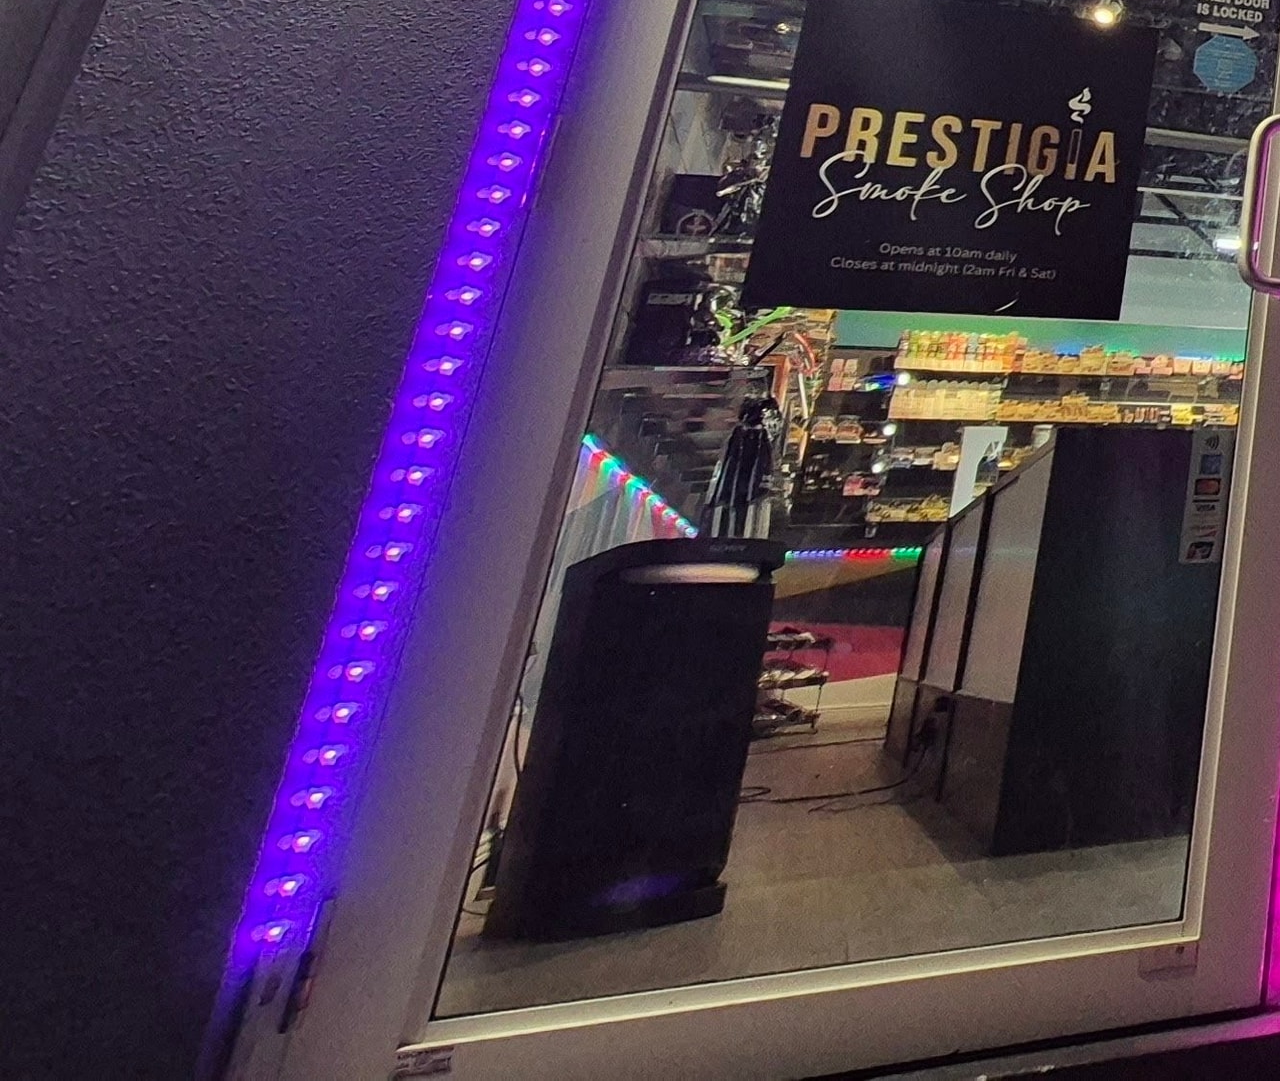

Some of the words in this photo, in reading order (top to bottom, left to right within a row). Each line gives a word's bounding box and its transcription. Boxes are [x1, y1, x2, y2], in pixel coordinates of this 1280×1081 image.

[1196, 3, 1210, 15] IS
[1213, 5, 1263, 22] LOCKED
[800, 102, 1117, 184] PRESTIGIA
[812, 150, 968, 221] Smoke
[974, 163, 1091, 236] Shop
[879, 243, 924, 257] Opens
[927, 245, 942, 257] at
[944, 246, 982, 259] 10am
[985, 248, 1018, 263] daily
[830, 256, 877, 270] Closes
[881, 259, 895, 271] at
[898, 259, 959, 277] midnight
[962, 263, 995, 277] (2am
[998, 264, 1016, 277] Fri
[1019, 266, 1028, 278] &
[1030, 266, 1057, 280] Sat)
